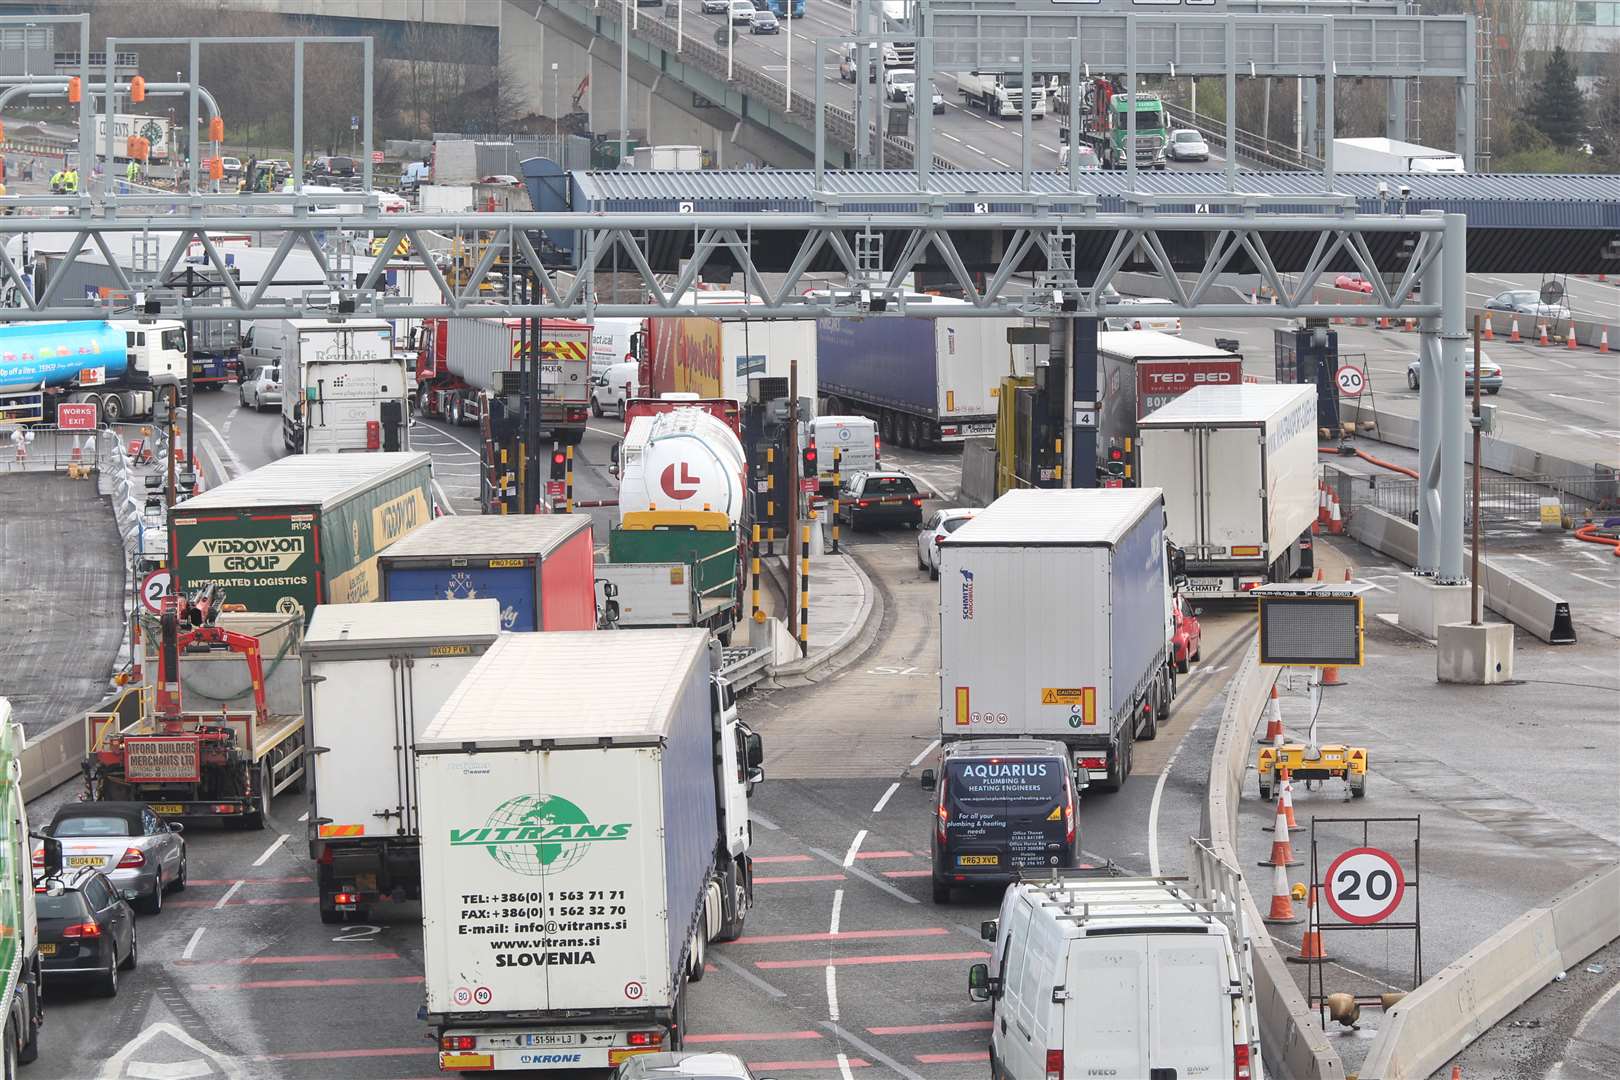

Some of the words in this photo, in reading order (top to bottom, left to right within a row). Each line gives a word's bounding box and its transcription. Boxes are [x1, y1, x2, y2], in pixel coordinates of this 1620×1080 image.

[1150, 373, 1185, 383] TED
[1193, 372, 1231, 382] BED
[1340, 374, 1362, 387] 20
[63, 408, 92, 416] WORKS
[1081, 414, 1090, 424] 4
[224, 556, 280, 570] GROUP
[254, 575, 308, 587] LOGISTICS
[159, 743, 195, 754] BUILDERS
[131, 755, 180, 766] MERCHANTS
[181, 755, 194, 766] LTD
[963, 764, 1047, 777] AQUARIUS
[946, 820, 975, 828] plumbing
[983, 819, 1007, 828] heating
[450, 823, 632, 842] VITRANS
[70, 857, 89, 865] BU04
[90, 856, 105, 864] ATK
[961, 856, 981, 864] YR63
[1337, 869, 1393, 901] 20
[548, 892, 554, 901] 1
[559, 891, 584, 901] 563
[588, 891, 604, 901] 71
[609, 890, 625, 900] 71
[549, 907, 555, 917] 1
[560, 906, 585, 916] 562
[589, 906, 606, 916] 32
[609, 905, 626, 916] 70
[332, 924, 382, 941] 2
[458, 923, 509, 935] E-mail:
[514, 919, 627, 934] info@vitrans.si
[490, 936, 601, 950] www.vitrans.si
[495, 951, 596, 968] SLOVENIA
[478, 991, 488, 1000] 90
[629, 986, 639, 995] 70
[458, 992, 468, 1001] 80
[532, 1054, 581, 1064] KRONE
[1088, 1069, 1117, 1077] IVECO
